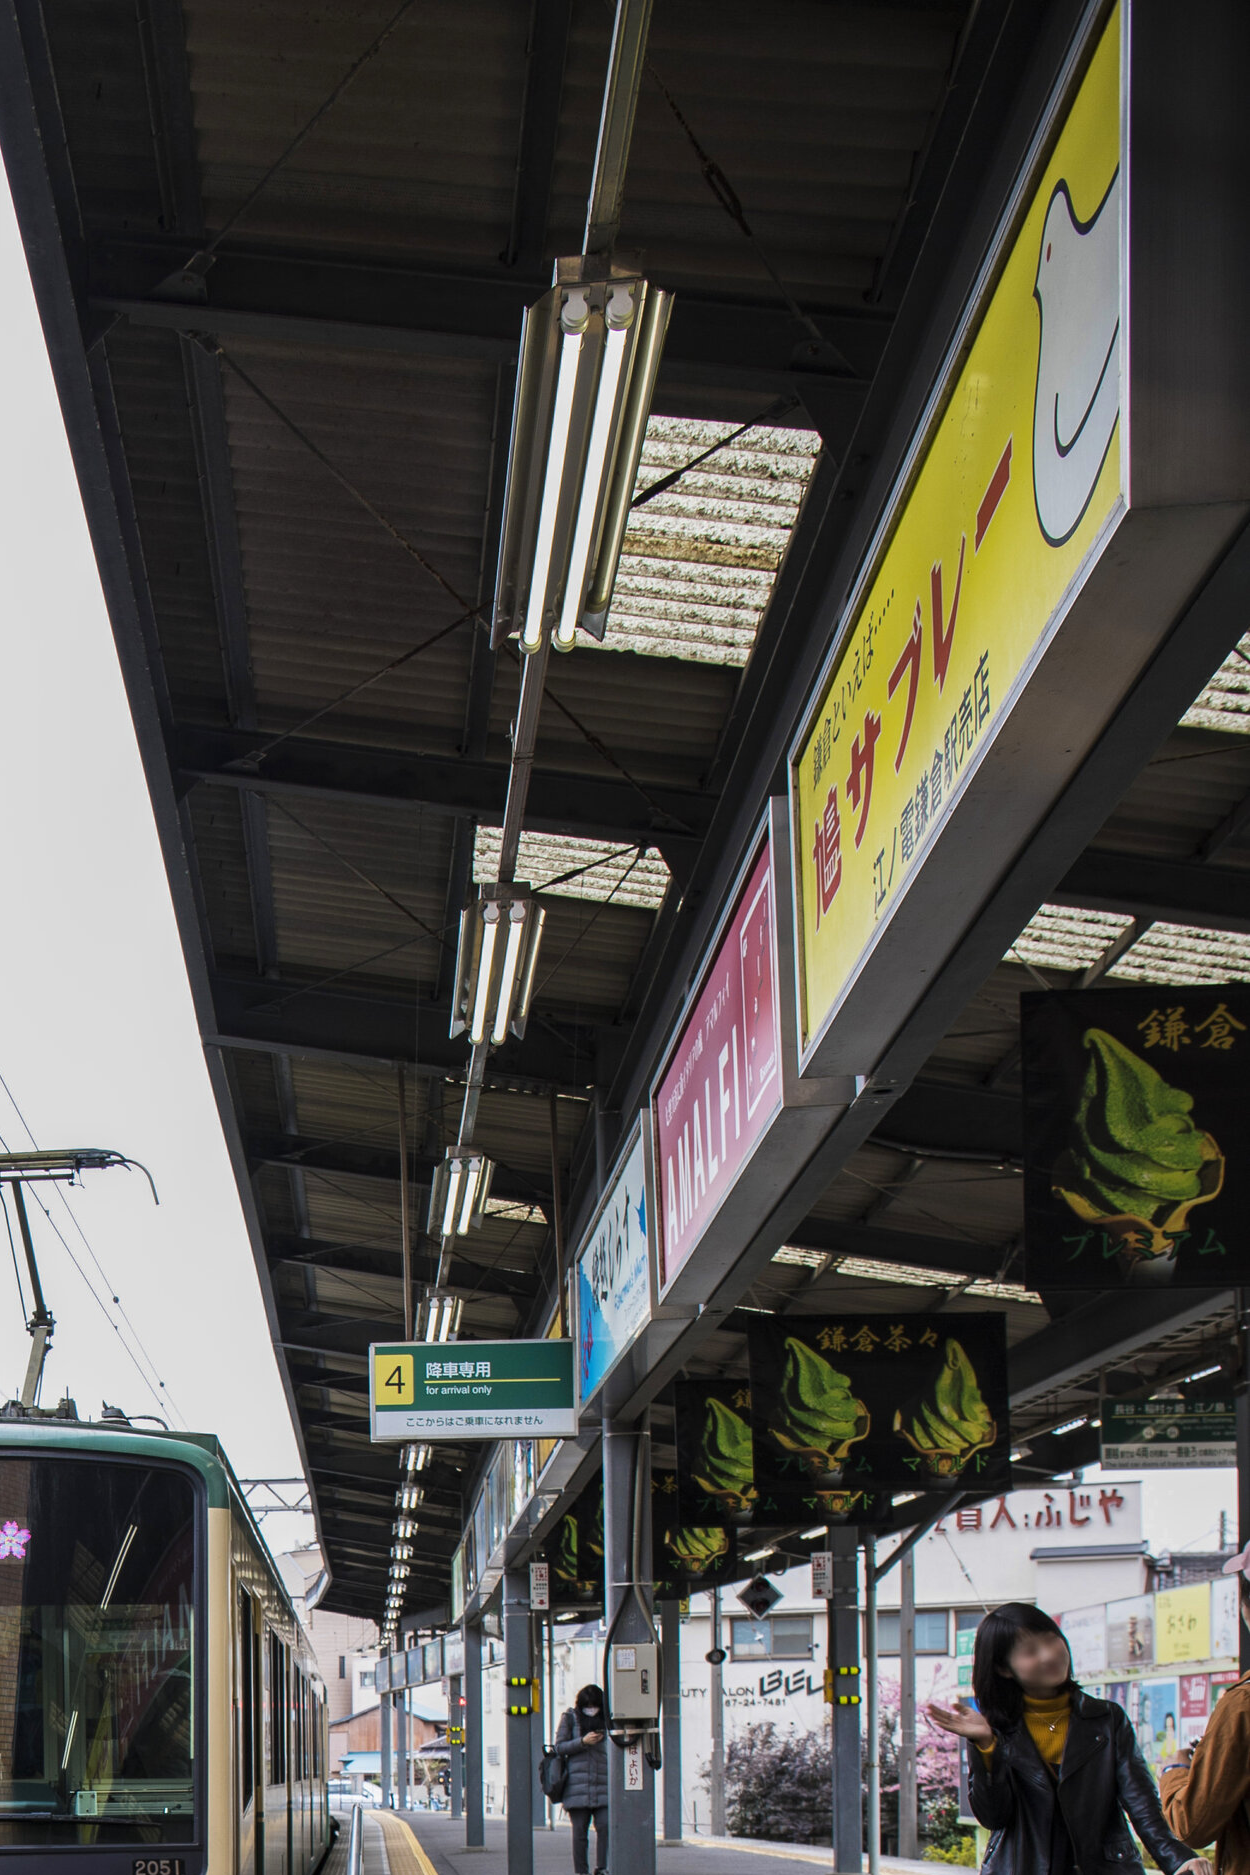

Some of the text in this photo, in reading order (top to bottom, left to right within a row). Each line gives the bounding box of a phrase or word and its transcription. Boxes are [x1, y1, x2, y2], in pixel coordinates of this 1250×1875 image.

[812, 436, 1014, 934] 鳩サブレー
[873, 650, 990, 916] 江ノ電鎌倉駅売店
[1137, 1003, 1247, 1052] 鎌倉
[667, 1024, 741, 1256] AMALFI
[1062, 1227, 1227, 1261] プレミアム
[816, 1323, 939, 1353] 鎌倉茶々
[384, 1365, 405, 1394] 4
[426, 1361, 491, 1378] 降車専用
[426, 1384, 492, 1397] for arrival only
[406, 1415, 544, 1428] ここからはご乗車になれません
[775, 1453, 990, 1474] プレミアム マイルド
